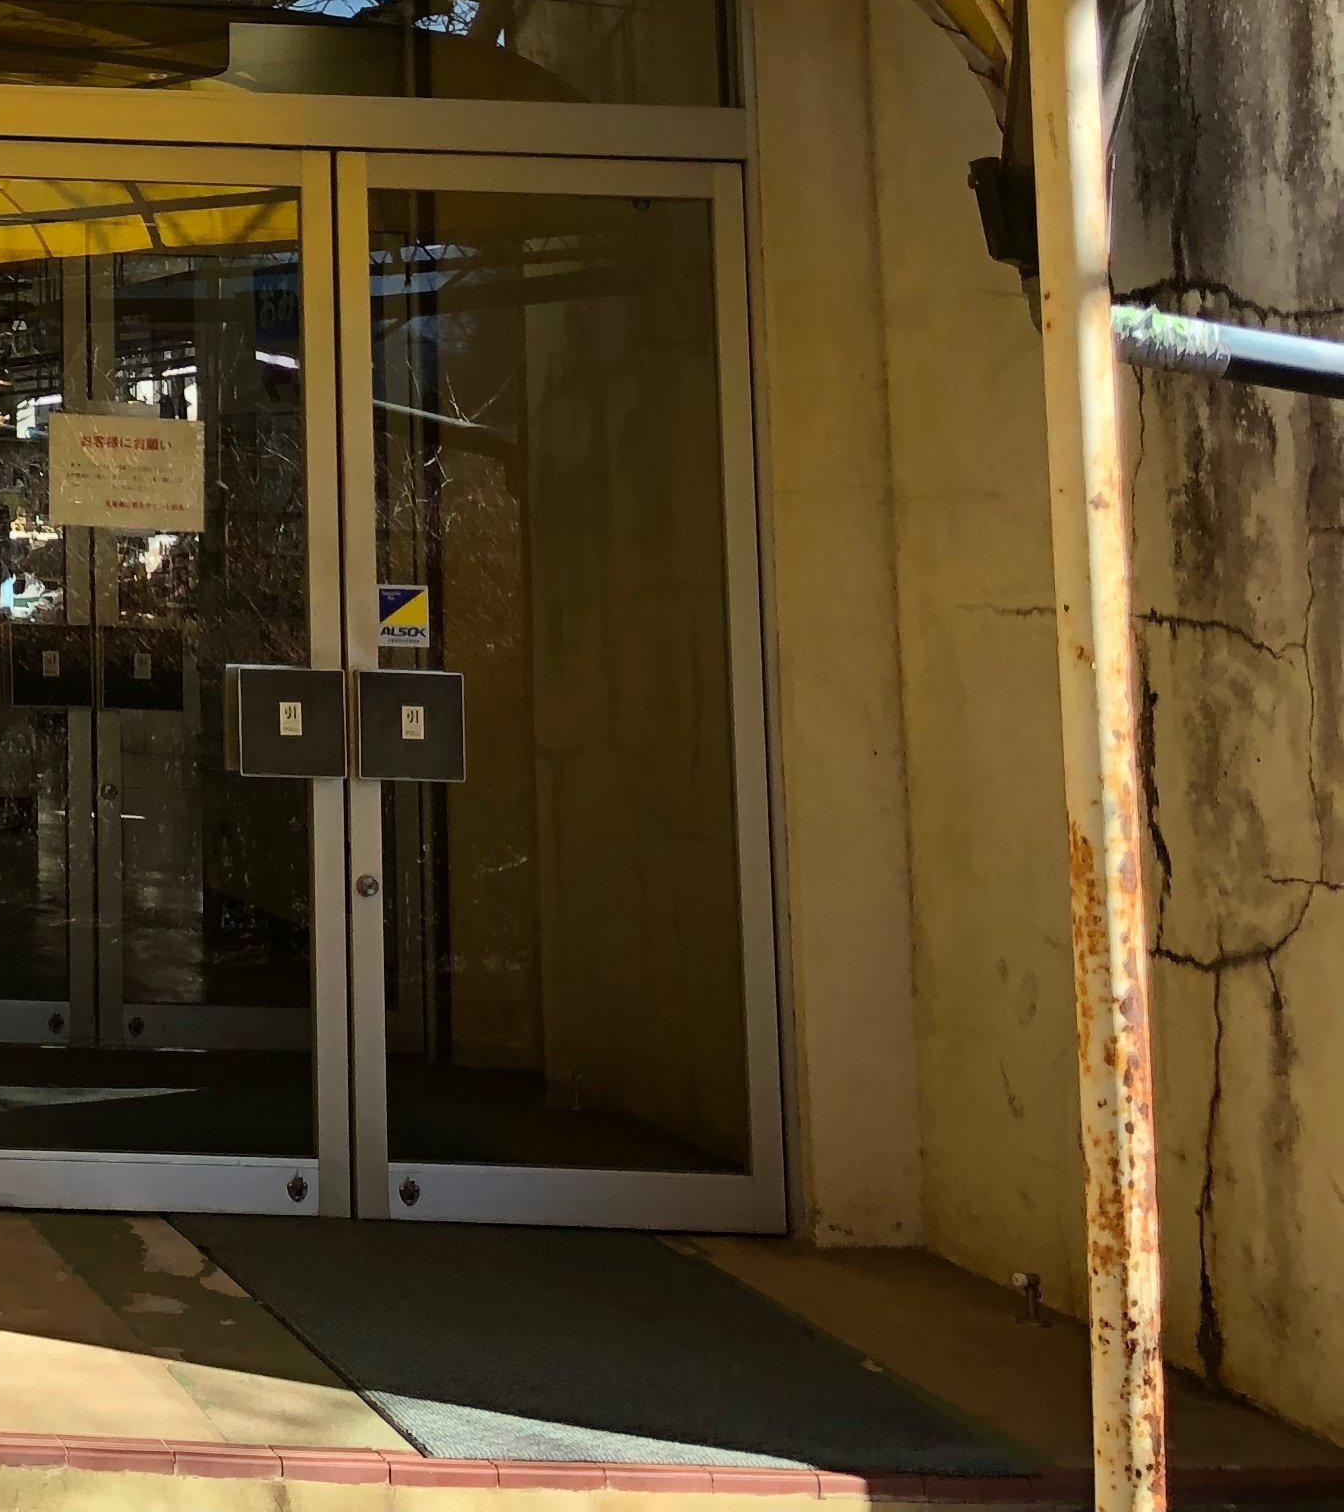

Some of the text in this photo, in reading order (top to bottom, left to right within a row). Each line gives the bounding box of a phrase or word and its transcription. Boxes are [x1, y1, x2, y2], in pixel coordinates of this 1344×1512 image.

[80, 434, 172, 451] お客様にお願い
[380, 626, 427, 638] ALSOK
